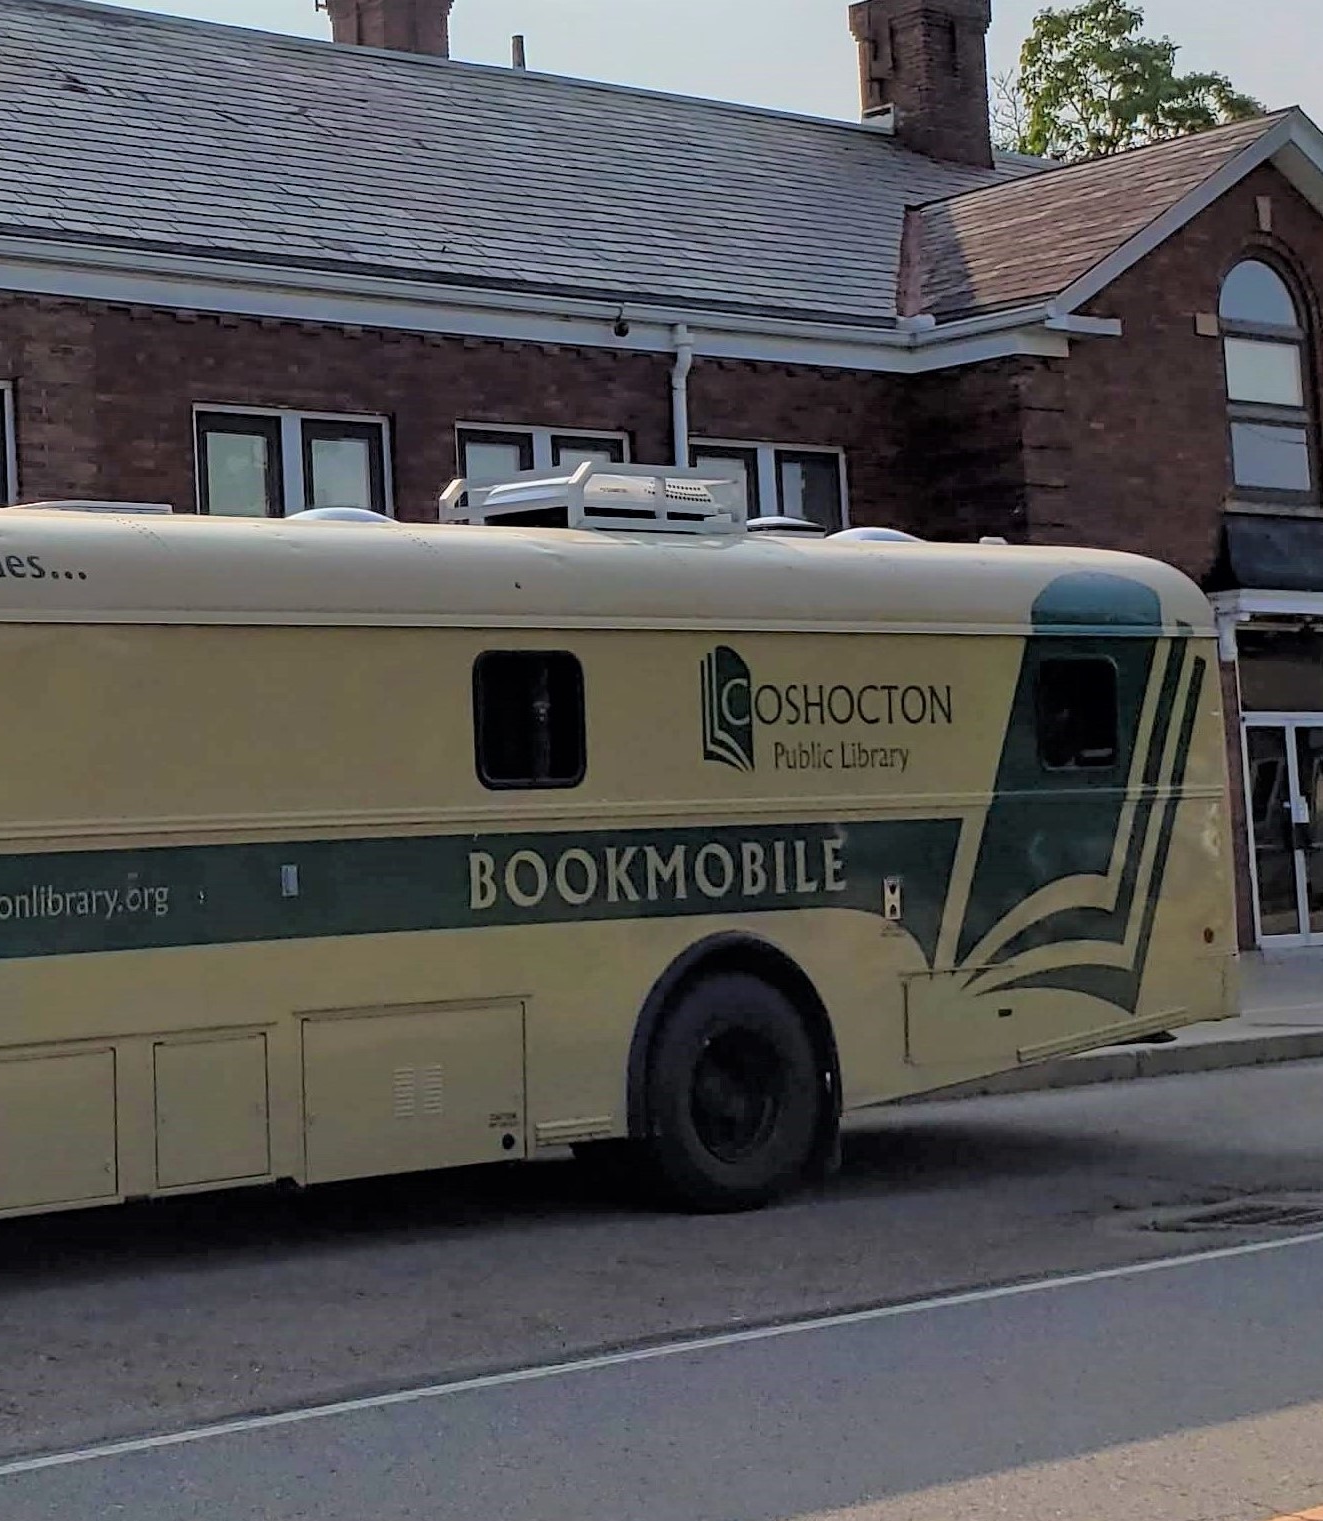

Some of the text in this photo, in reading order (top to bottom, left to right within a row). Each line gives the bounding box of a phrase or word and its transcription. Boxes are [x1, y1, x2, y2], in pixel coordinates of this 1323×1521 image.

[721, 678, 953, 726] COSHOCTON
[774, 741, 910, 773] Public Library
[469, 838, 848, 909] BOOKMOBILE
